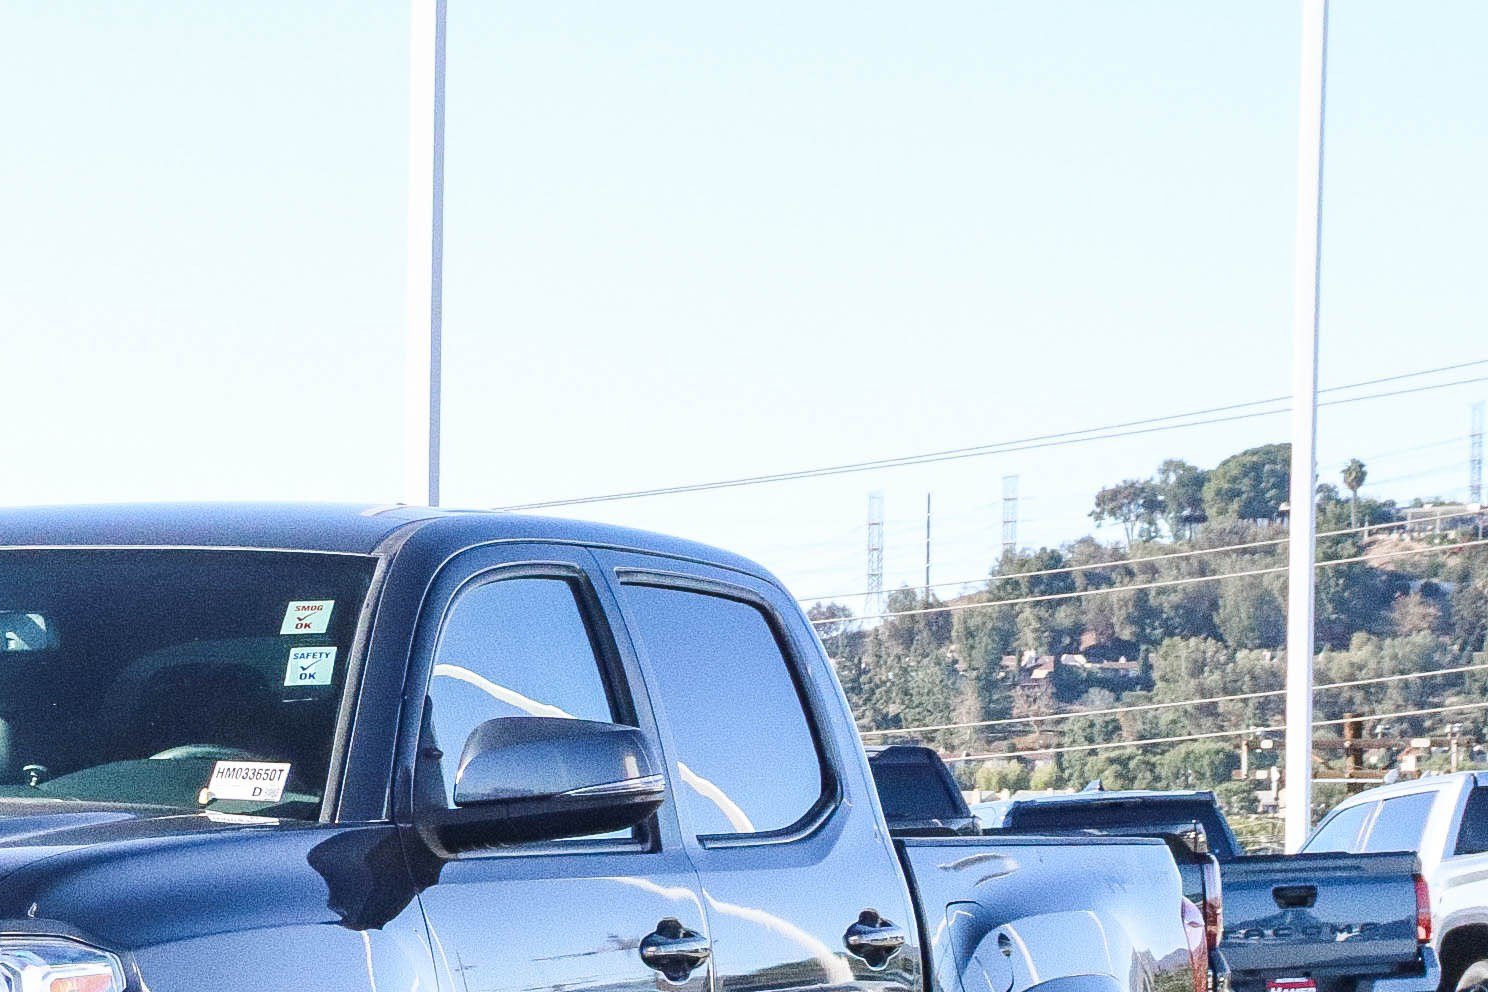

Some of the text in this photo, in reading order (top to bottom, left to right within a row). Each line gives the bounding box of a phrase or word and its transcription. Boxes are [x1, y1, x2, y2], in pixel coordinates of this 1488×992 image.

[293, 652, 332, 660] SAFETY
[299, 672, 317, 681] OK
[215, 767, 285, 782] HM033650T
